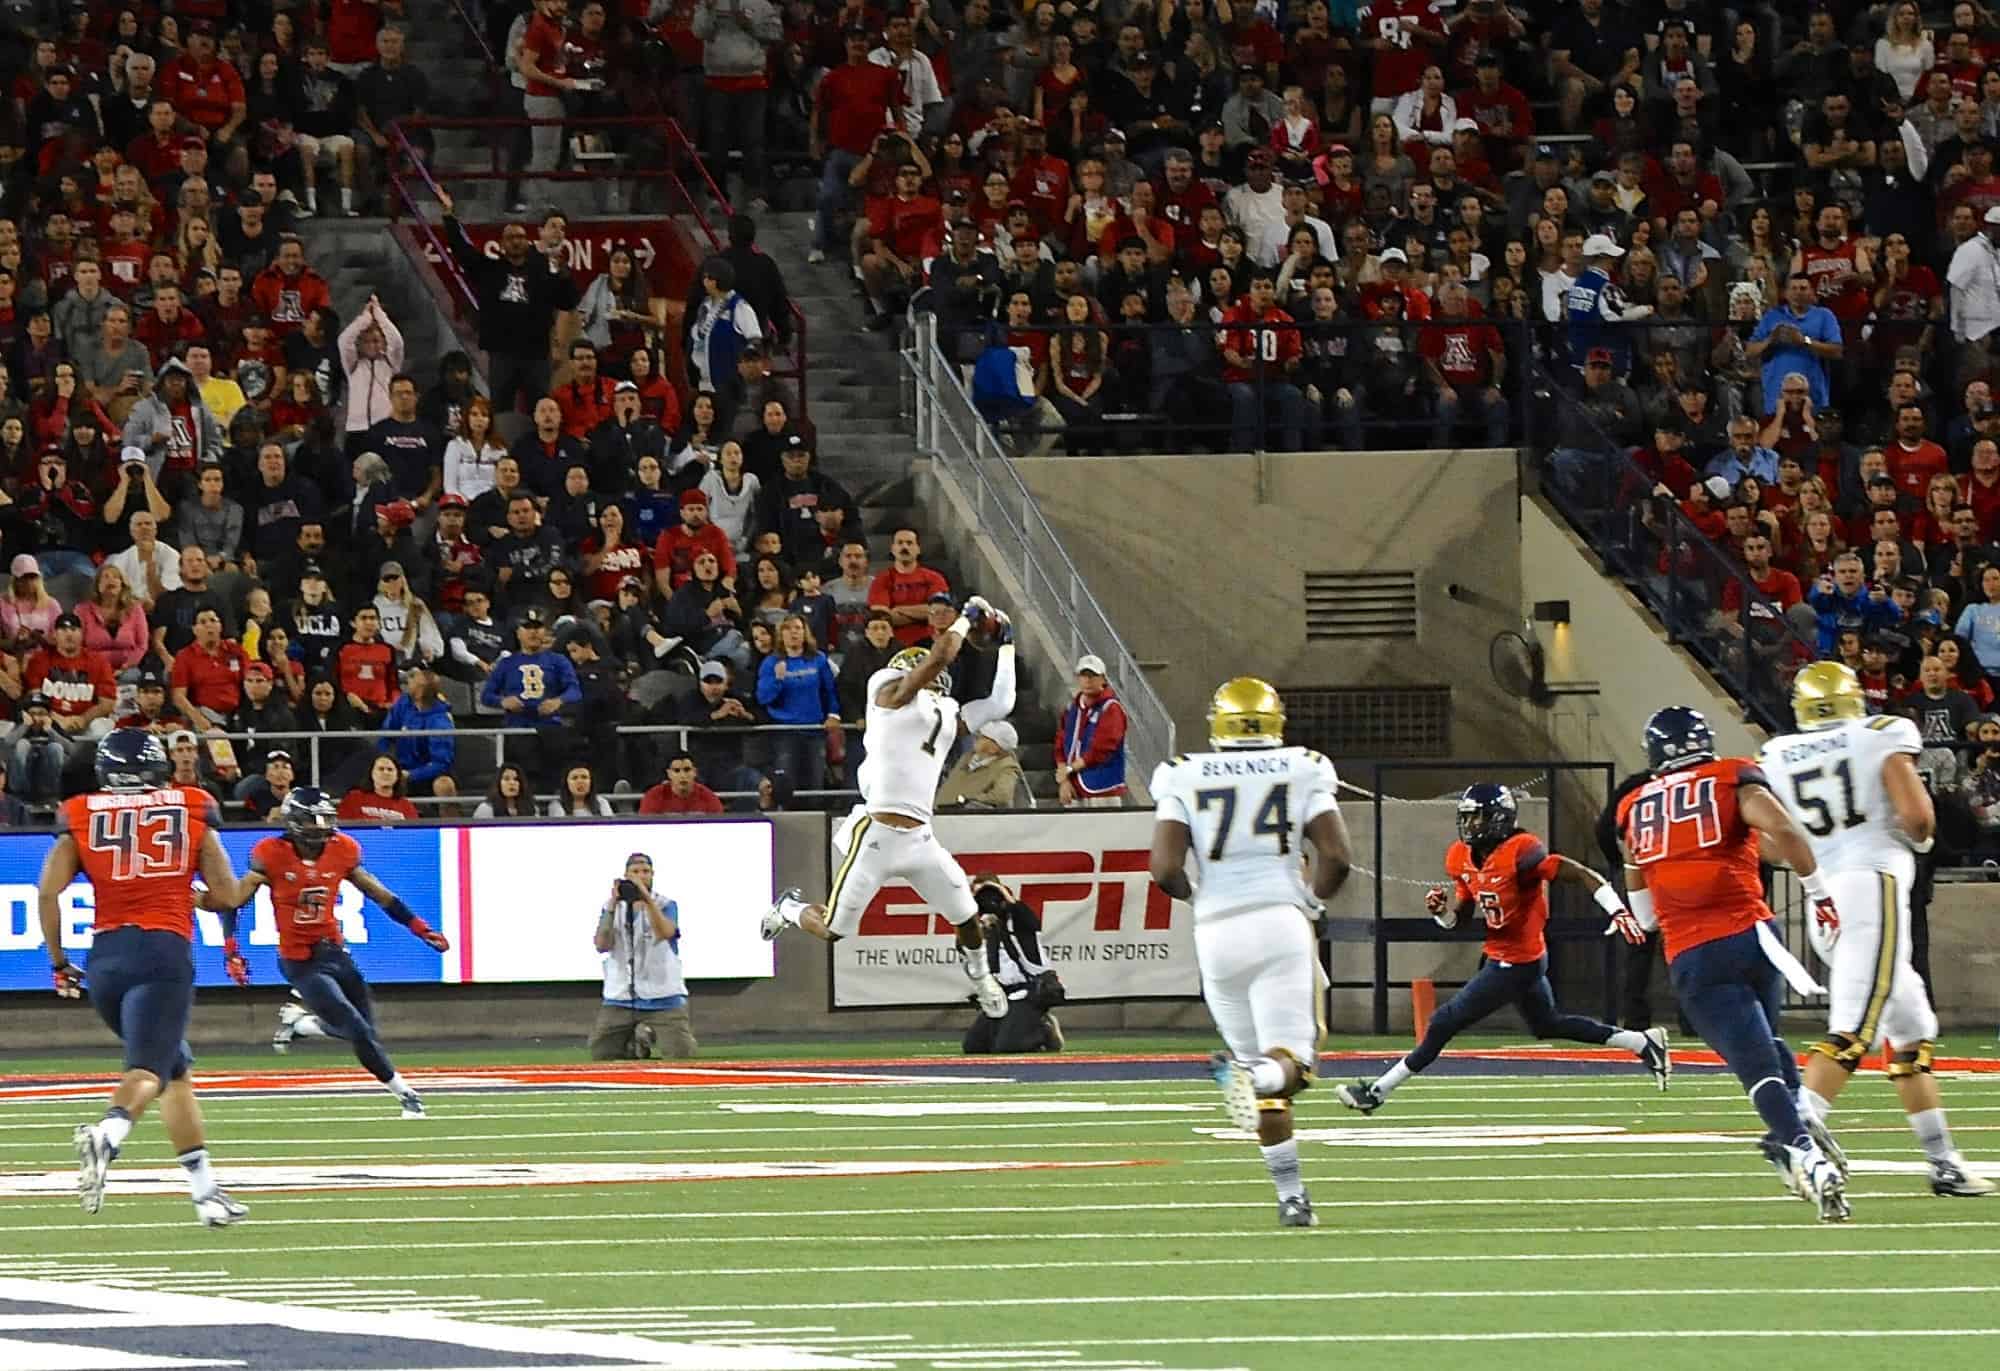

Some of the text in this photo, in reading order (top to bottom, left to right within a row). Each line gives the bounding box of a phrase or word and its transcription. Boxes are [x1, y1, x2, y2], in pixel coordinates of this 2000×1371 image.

[518, 664, 546, 701] B
[919, 706, 943, 757] 1
[1919, 708, 1957, 743] A
[1790, 757, 1868, 837] 51
[88, 806, 190, 881] 43
[1194, 782, 1294, 861] 74
[293, 885, 331, 924] 5
[855, 948, 889, 966] THE
[895, 947, 964, 966] WORLD
[1078, 944, 1096, 961] IN
[1102, 943, 1169, 961] SPORTS
